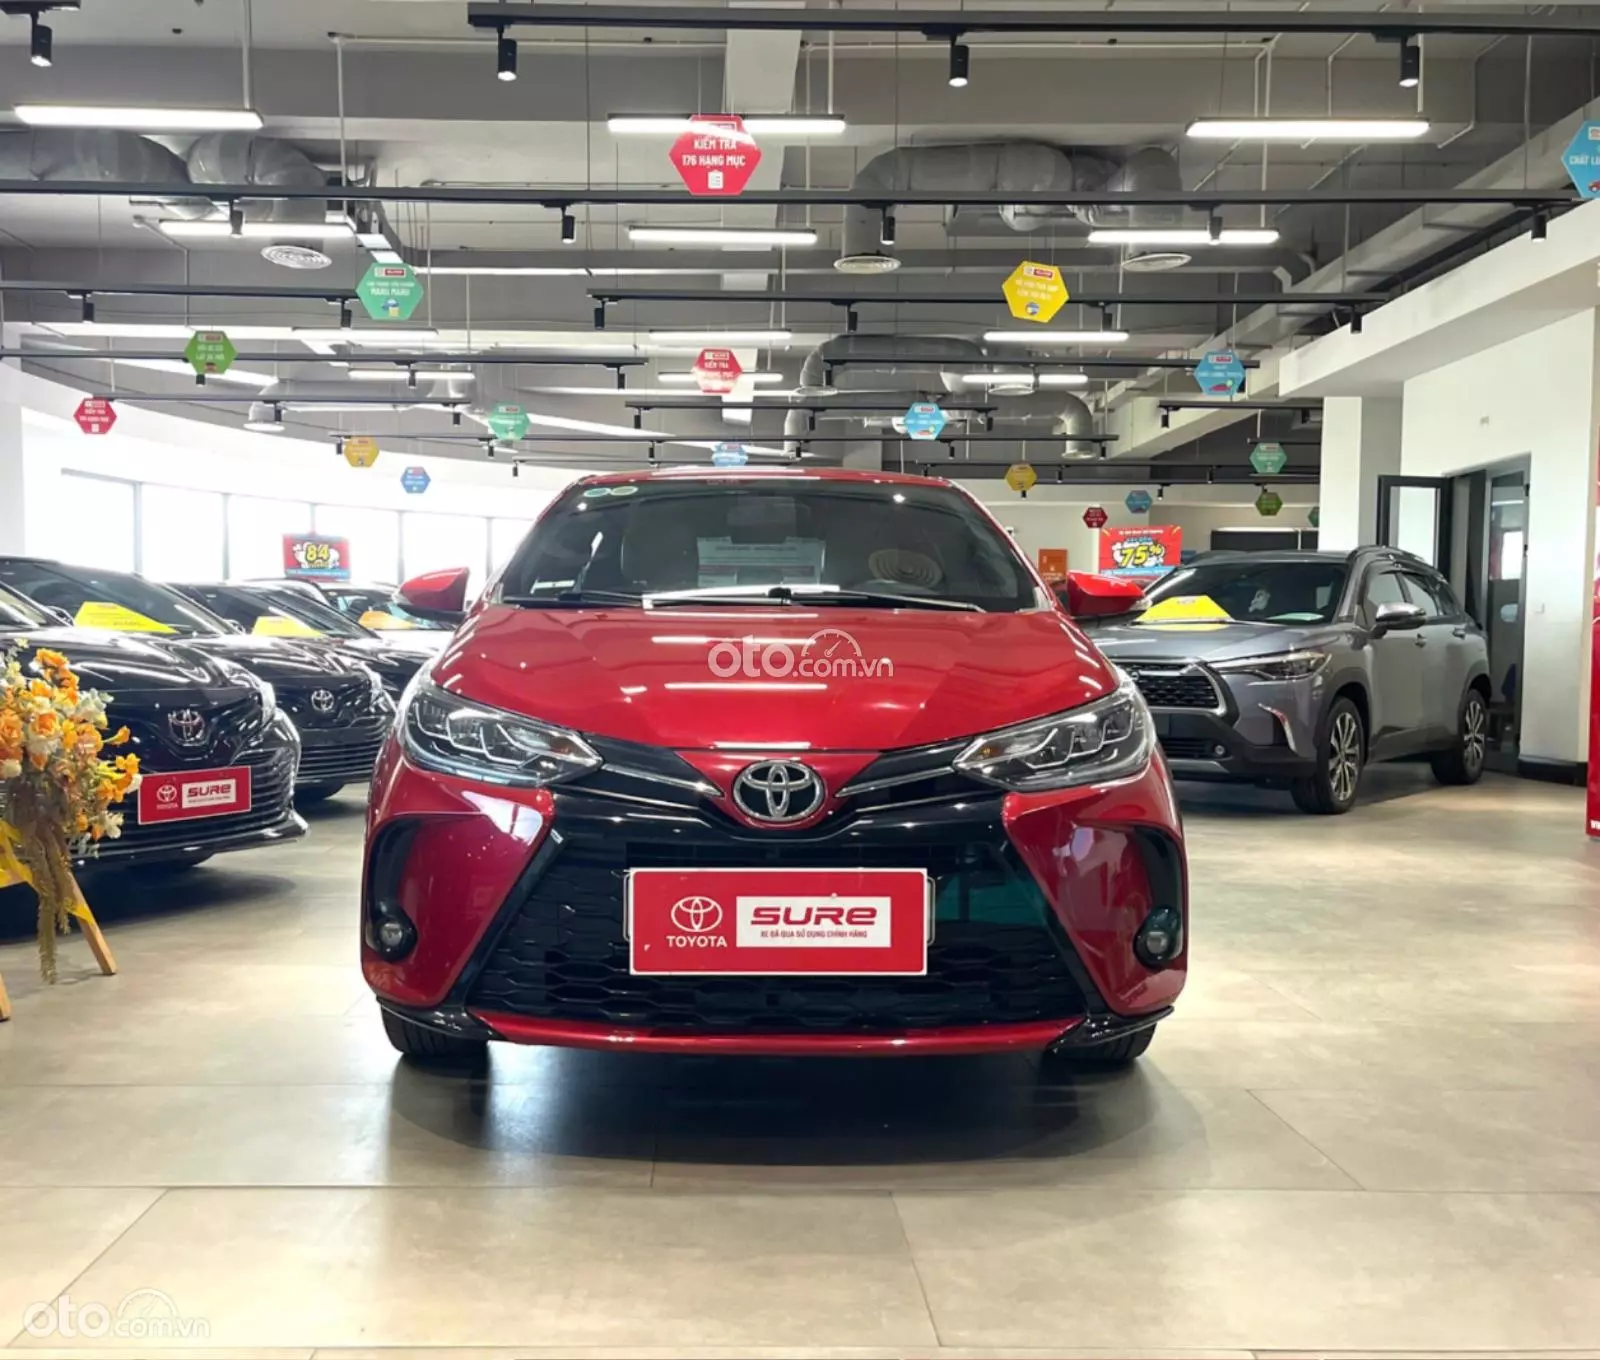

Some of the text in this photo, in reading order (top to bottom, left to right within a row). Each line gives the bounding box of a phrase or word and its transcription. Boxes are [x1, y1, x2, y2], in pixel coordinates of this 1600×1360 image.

[720, 139, 736, 149] TRA
[682, 154, 746, 168] 176 HẠNG MỤC
[1121, 543, 1162, 567] 75%
[667, 936, 727, 948] TOYOTA
